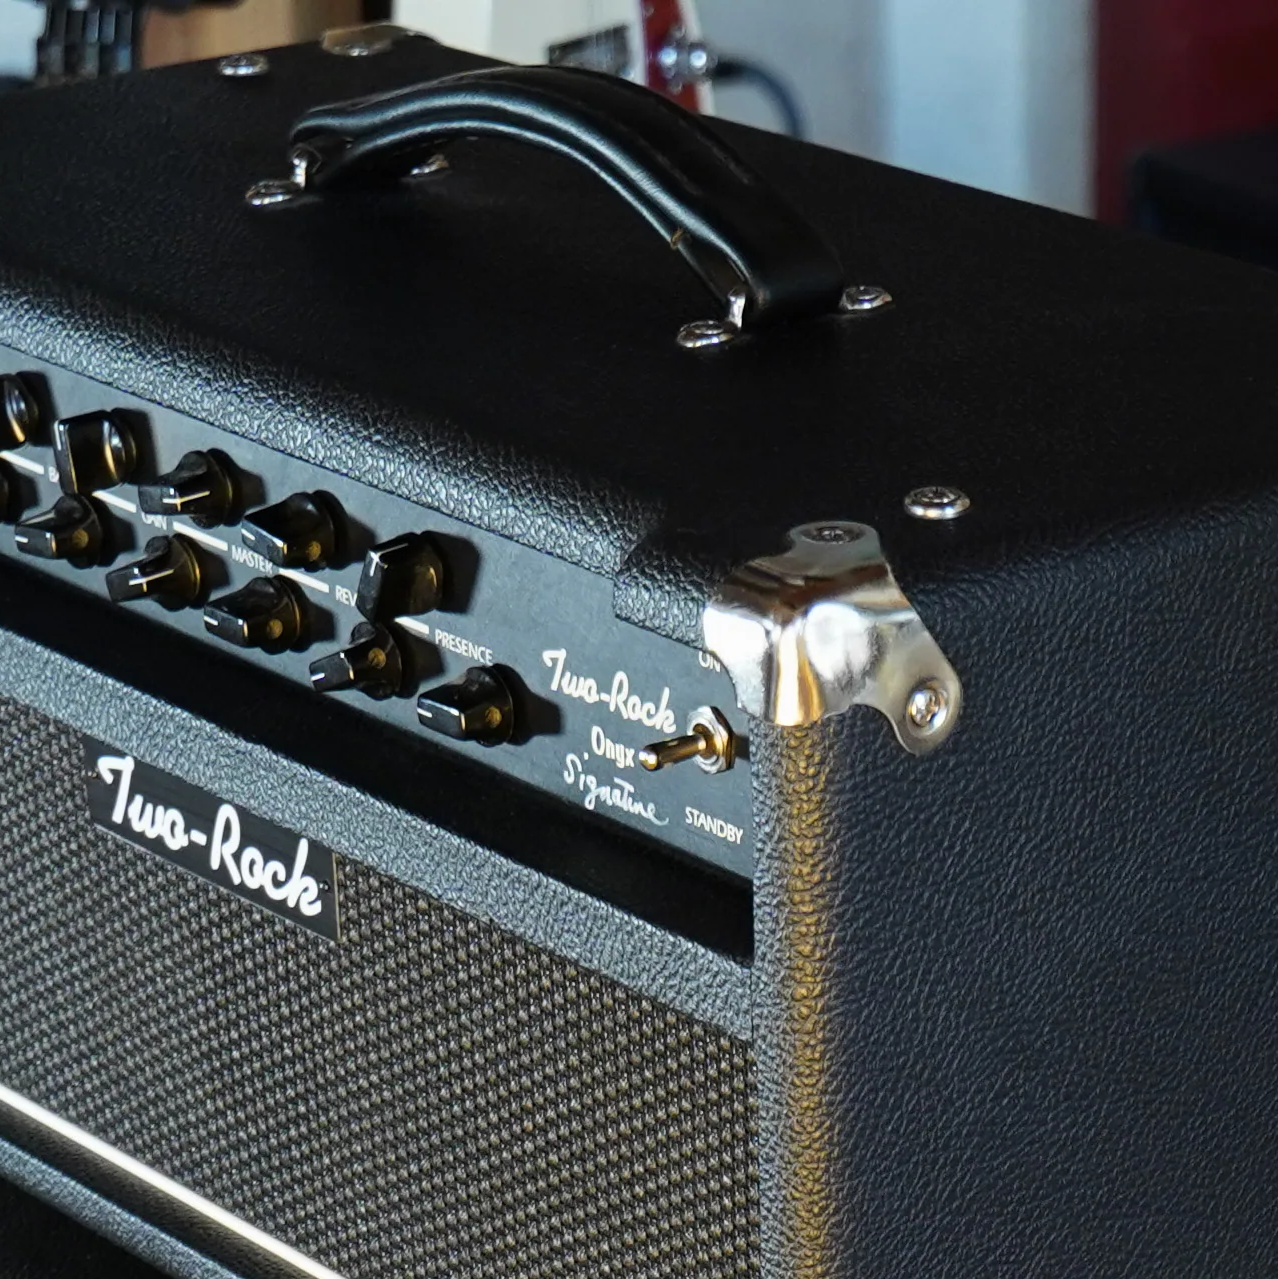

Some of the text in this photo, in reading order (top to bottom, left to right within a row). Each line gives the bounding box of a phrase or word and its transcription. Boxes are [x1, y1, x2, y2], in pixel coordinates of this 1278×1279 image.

[231, 544, 273, 575] MASTER
[335, 584, 358, 607] REV
[434, 628, 494, 665] PRESENCE
[542, 648, 677, 734] Two-Rock
[591, 725, 635, 768] Onyx
[563, 752, 669, 826] Signature
[97, 755, 322, 917] Two-Rock
[684, 806, 744, 845] STANDBY
